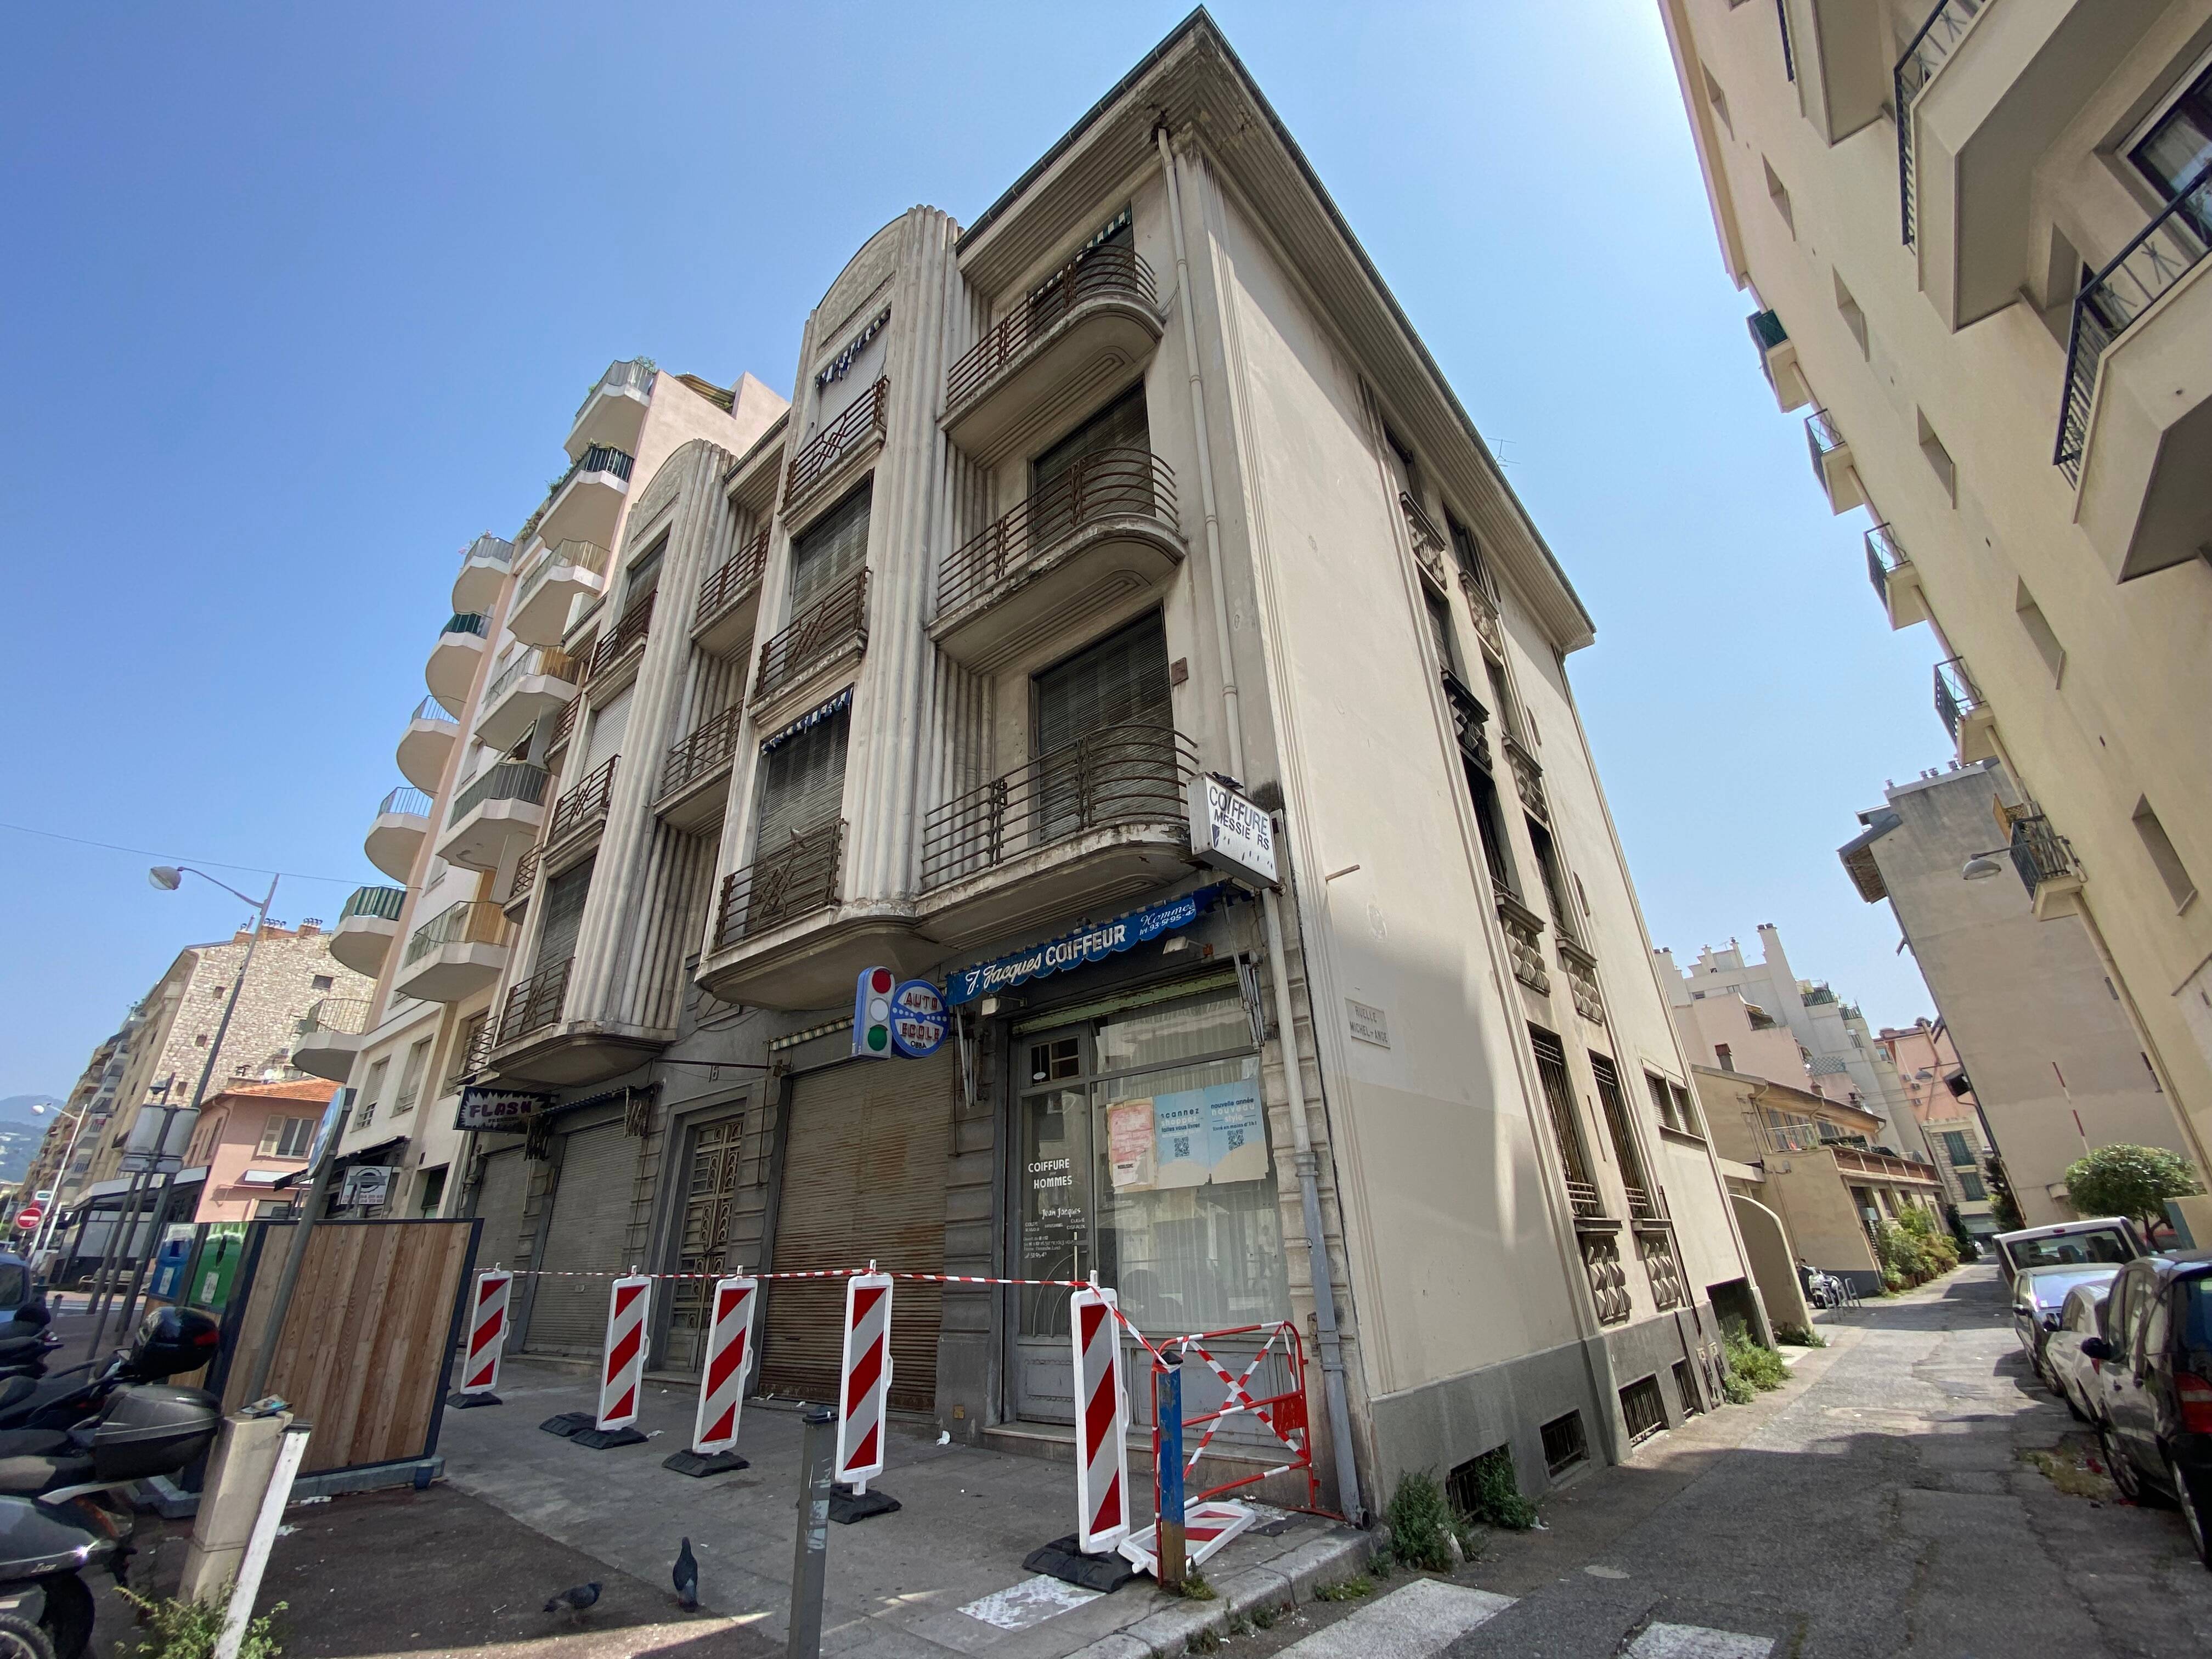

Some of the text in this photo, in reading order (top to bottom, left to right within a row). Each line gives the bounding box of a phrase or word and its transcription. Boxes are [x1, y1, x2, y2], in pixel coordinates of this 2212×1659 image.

[1210, 786, 1268, 836] COIFFURE
[983, 953, 1041, 989] Jacques
[1046, 924, 1126, 966] COIFFEUR
[904, 992, 938, 1010] AUTO
[1355, 1006, 1378, 1023] RUELLE
[900, 1023, 940, 1041] ECOLE
[1350, 1021, 1388, 1042] MICHEL-ANGE
[470, 1101, 532, 1118] FLASH
[1211, 1104, 1255, 1116] nouveau
[1161, 1116, 1197, 1127] shoppez
[1224, 1114, 1243, 1124] style
[1028, 1158, 1070, 1172] COIFFURE
[1034, 1175, 1073, 1189] HOMMES
[1041, 1207, 1081, 1220] Jean Jacques
